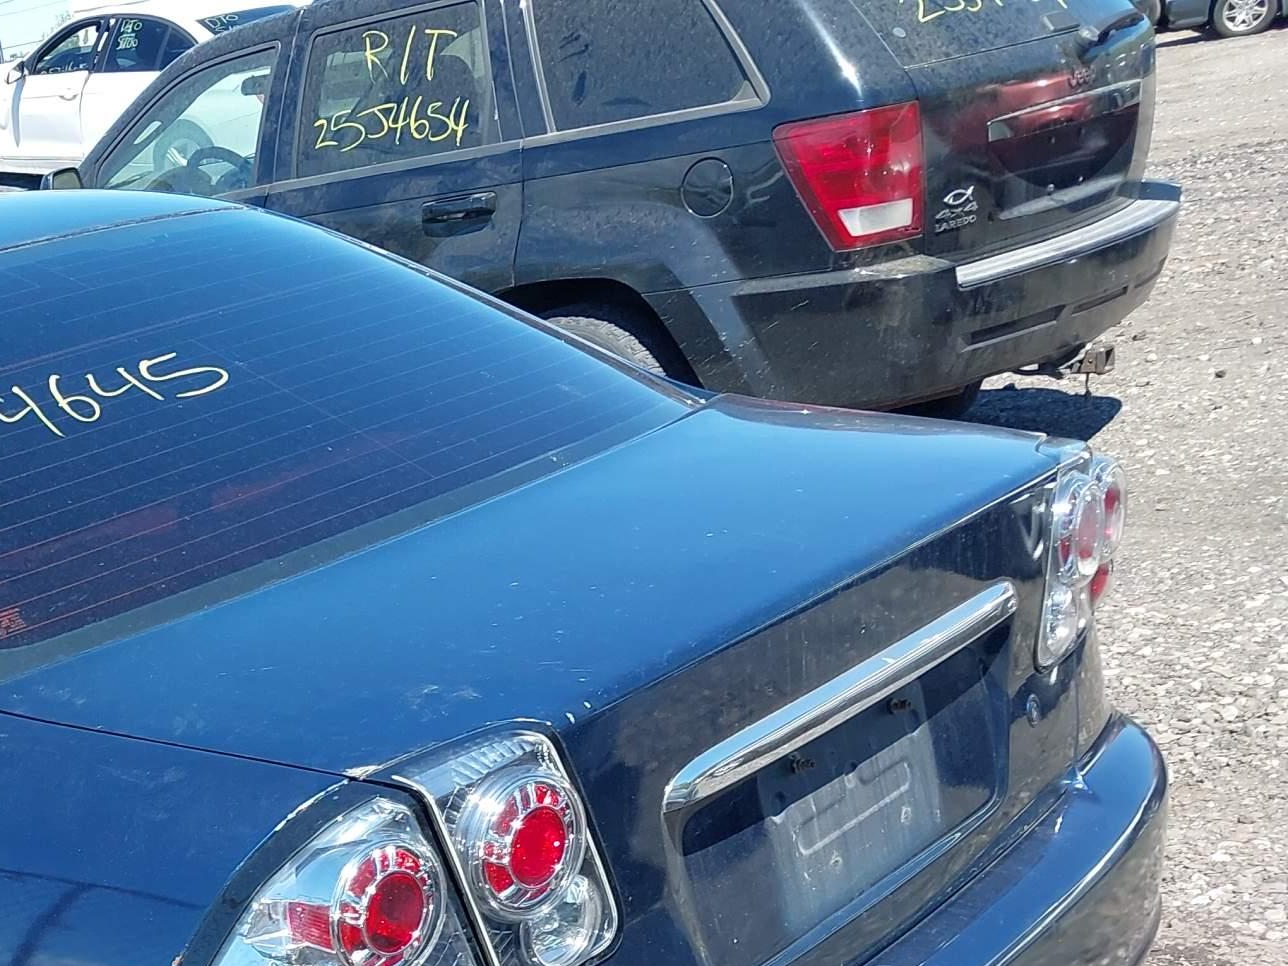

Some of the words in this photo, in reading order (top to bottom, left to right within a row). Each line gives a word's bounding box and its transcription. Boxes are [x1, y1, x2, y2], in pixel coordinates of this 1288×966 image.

[205, 14, 239, 28] DTO
[362, 25, 457, 85] R/T
[935, 214, 977, 232] LAREDO
